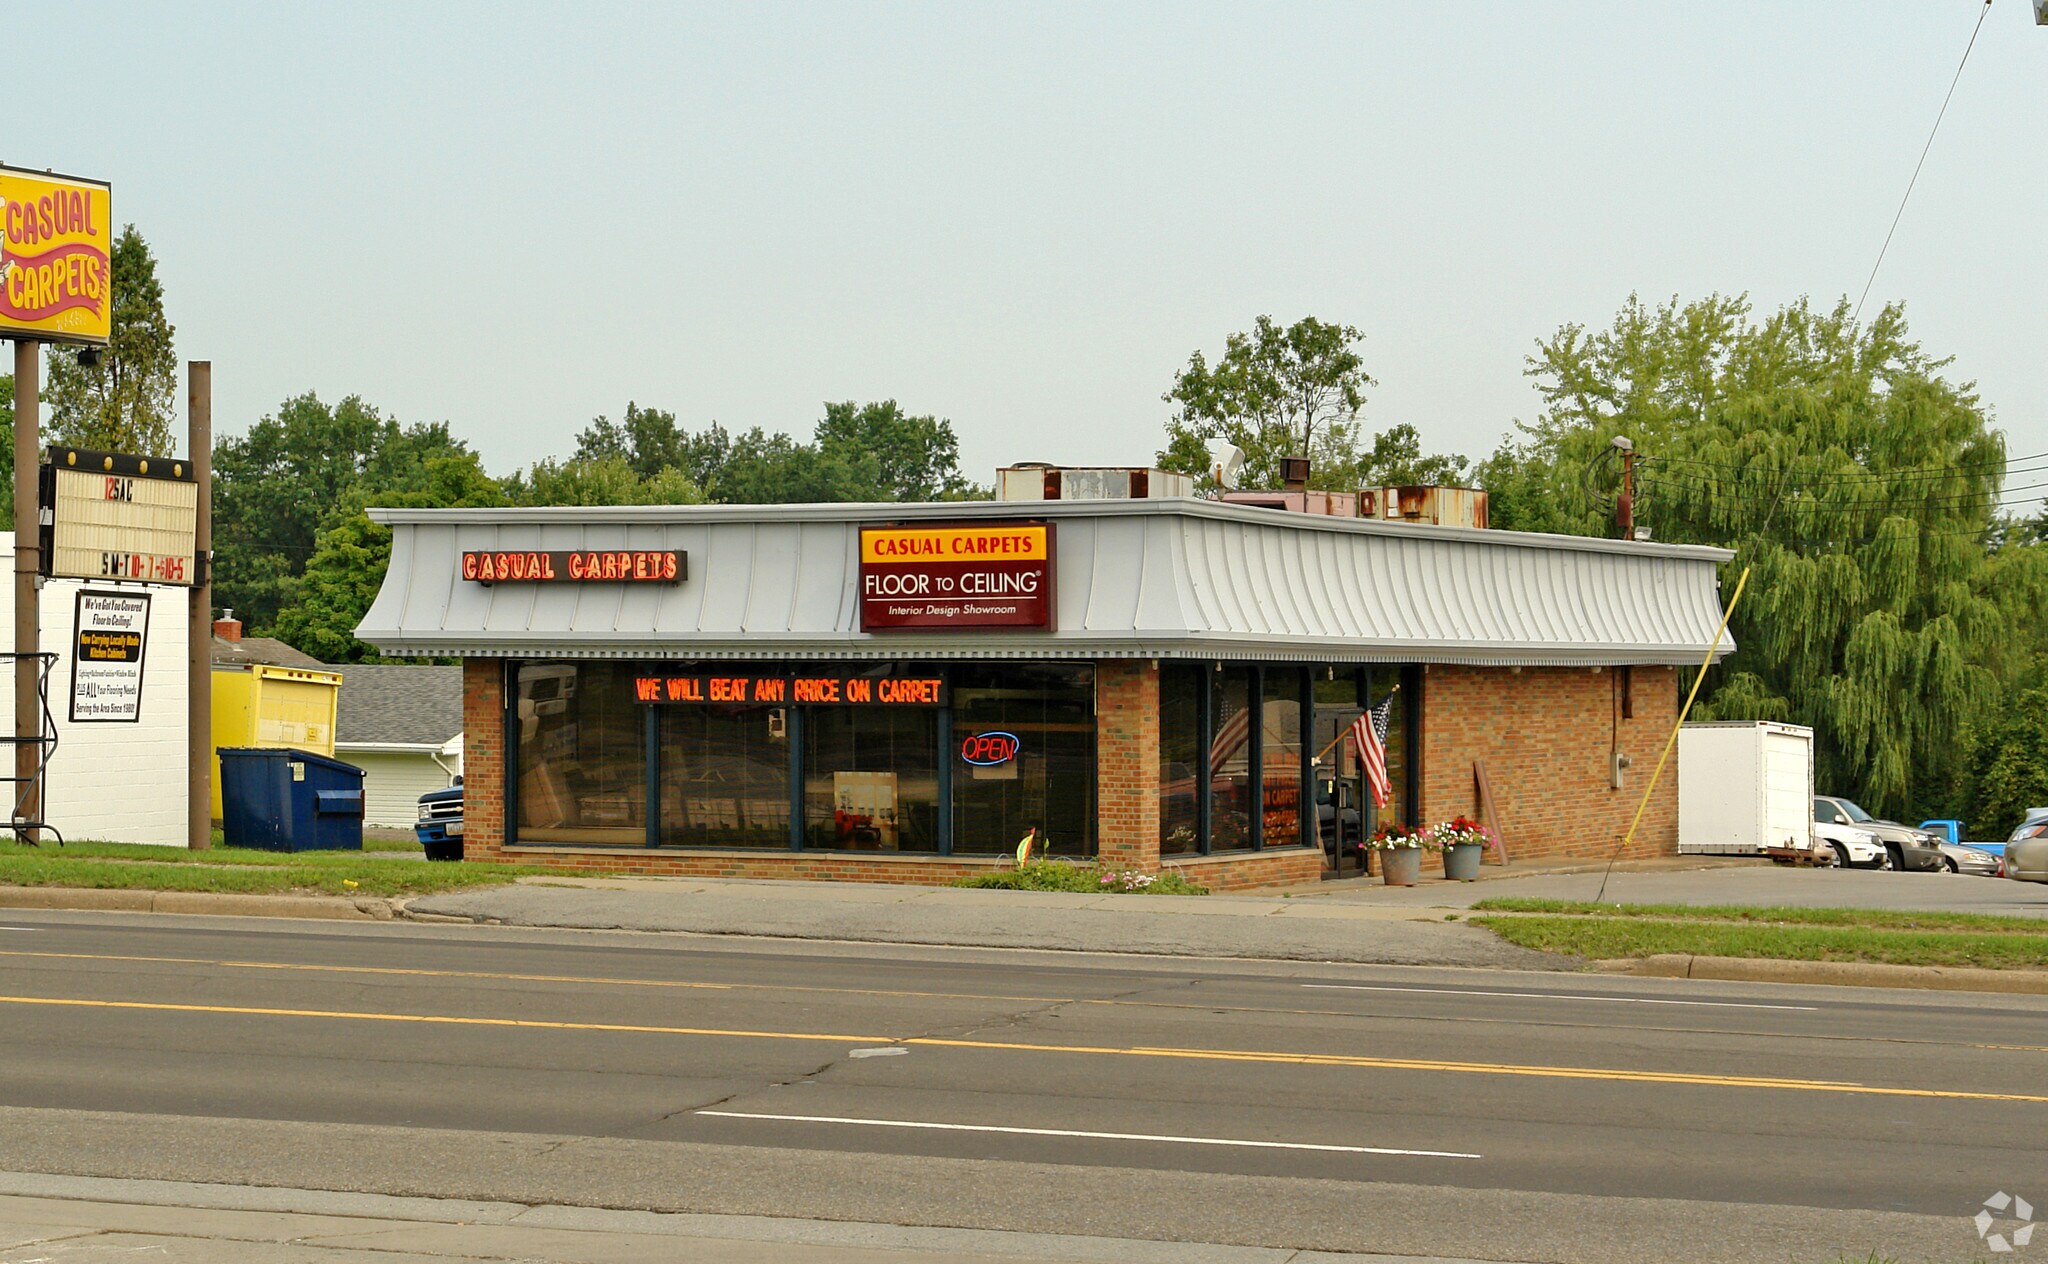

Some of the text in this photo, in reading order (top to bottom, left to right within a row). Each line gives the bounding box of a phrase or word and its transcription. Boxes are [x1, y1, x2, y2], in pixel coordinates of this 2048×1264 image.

[6, 189, 97, 245] CASUAL
[8, 253, 100, 310] CARPETS
[874, 535, 1033, 556] CASUAL CARPETS
[463, 552, 678, 579] CASUAL CARPETS
[865, 574, 930, 595] FLOOR
[935, 577, 955, 591] TO
[102, 598, 111, 610] Got
[111, 599, 121, 611] You
[121, 600, 143, 612] Covered
[888, 604, 1016, 617] Interior Design Showroom
[92, 613, 106, 625] Floor
[86, 682, 97, 698] ALL
[635, 678, 942, 703] WE WILL BEAT ANY PRICE ON CARPET
[962, 736, 1016, 760] OPEN
